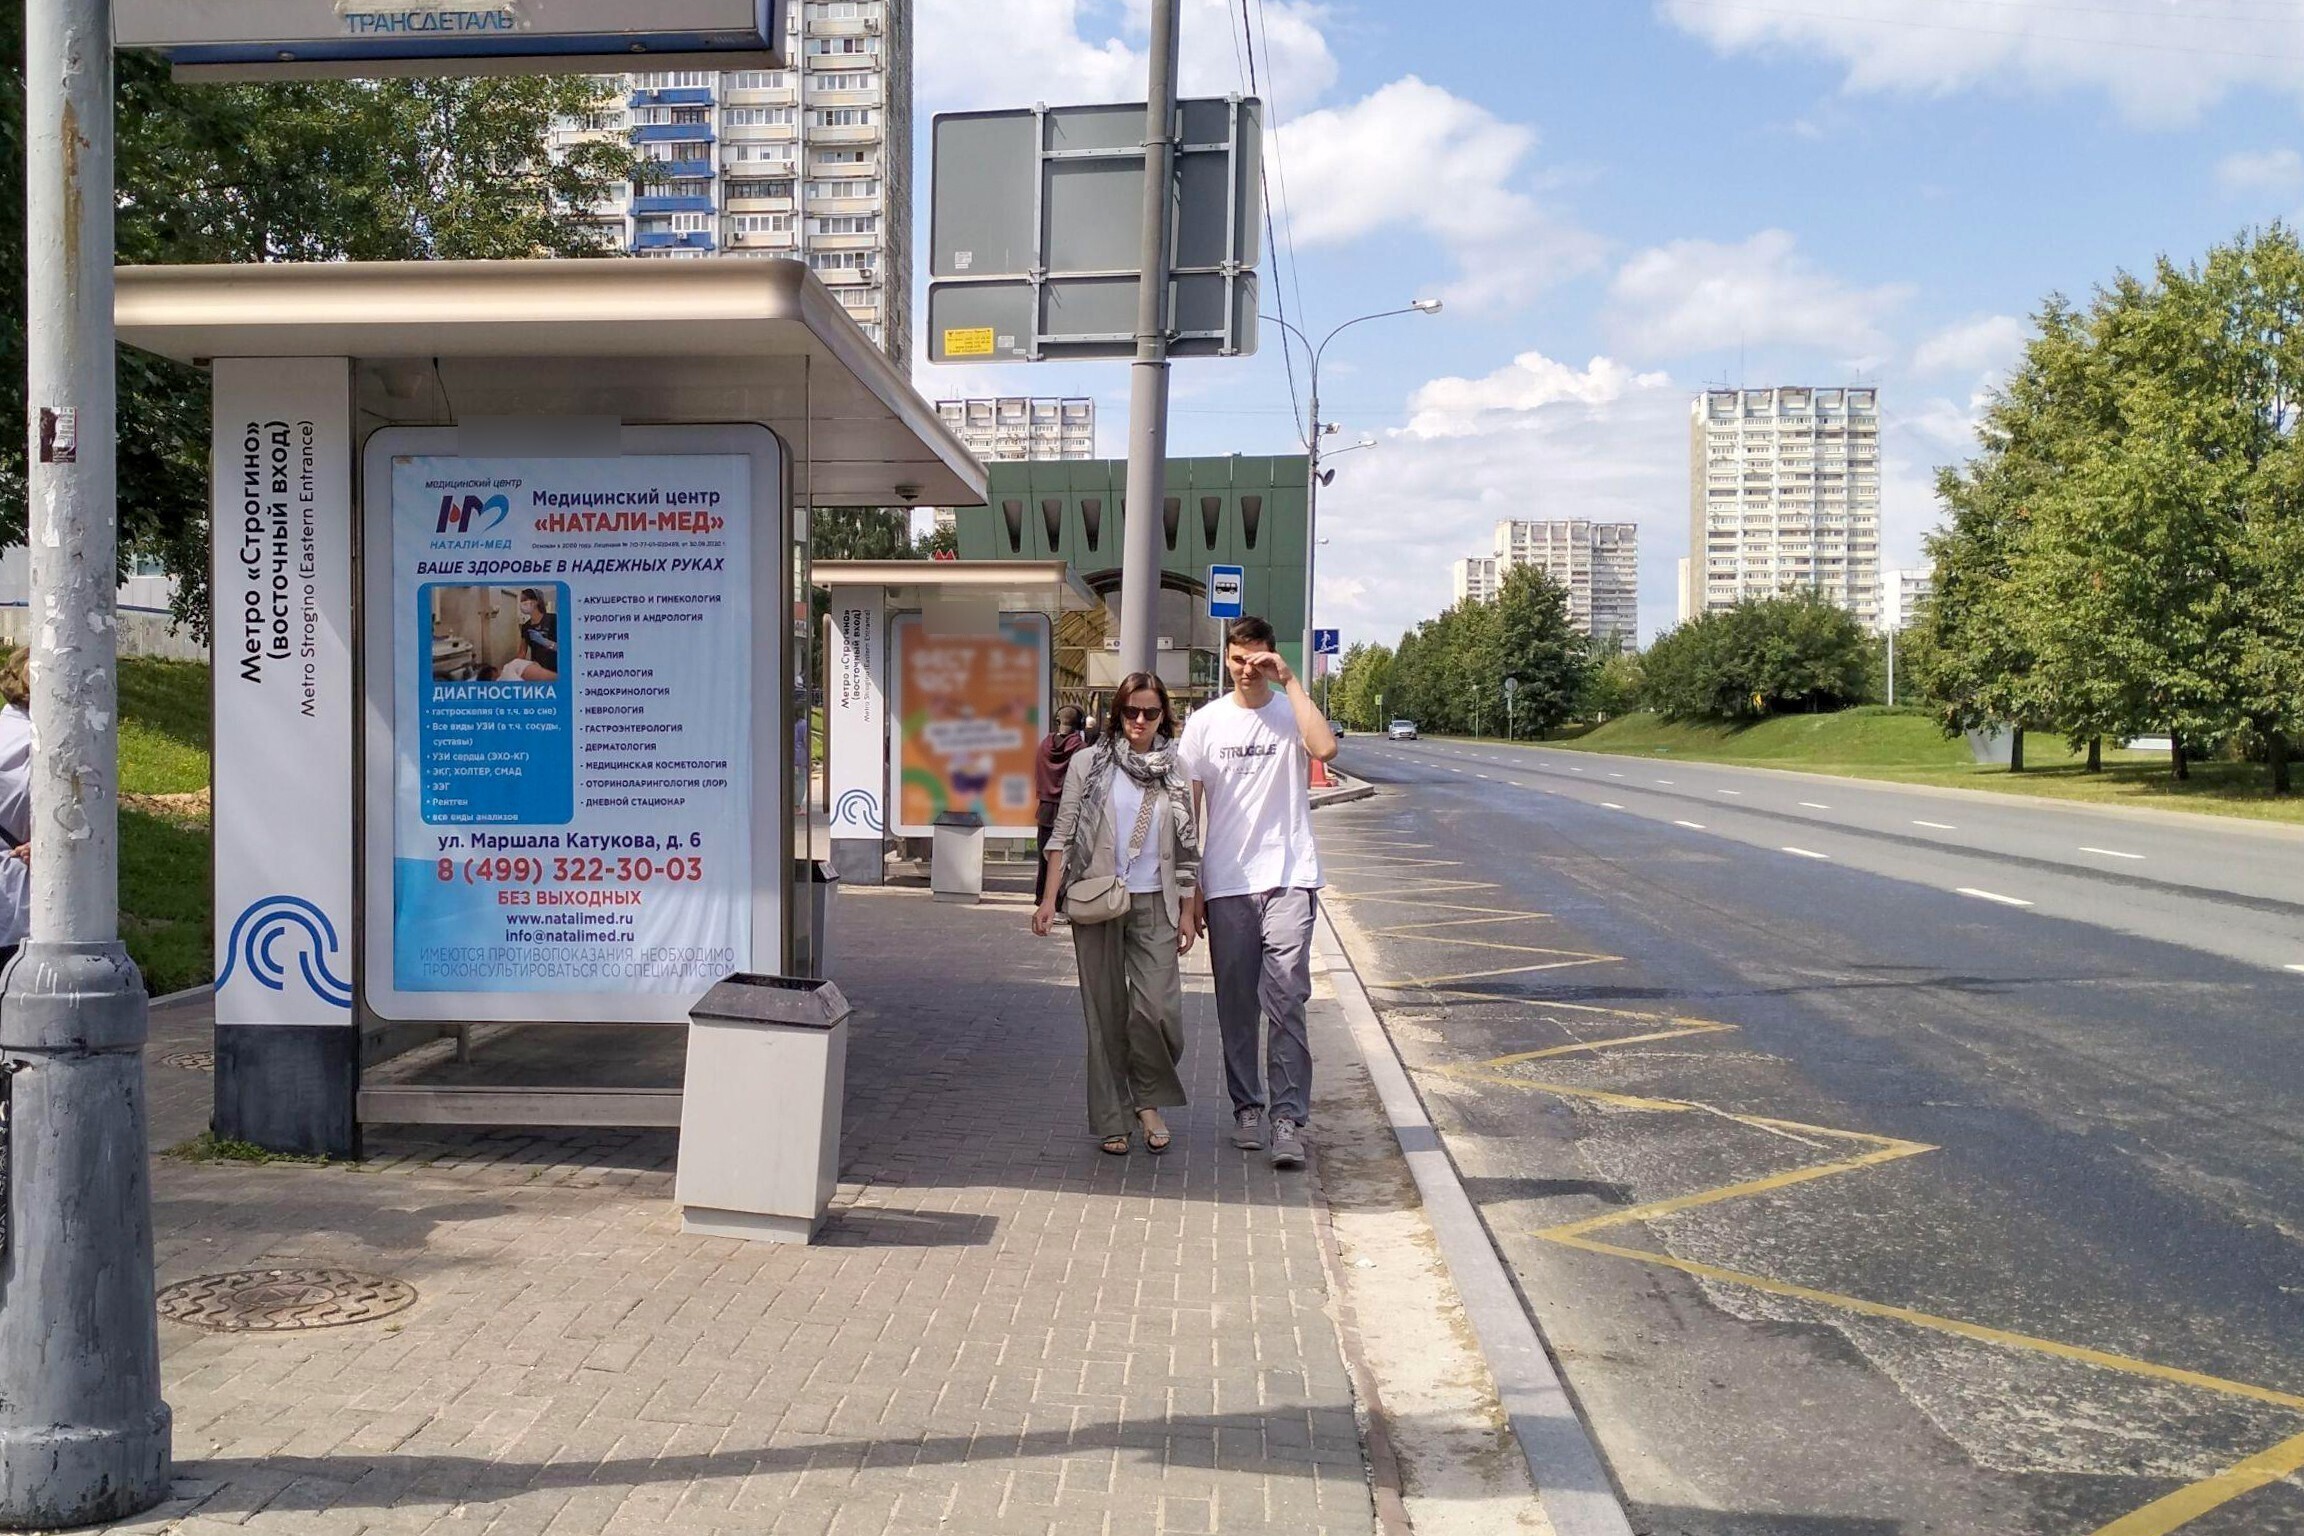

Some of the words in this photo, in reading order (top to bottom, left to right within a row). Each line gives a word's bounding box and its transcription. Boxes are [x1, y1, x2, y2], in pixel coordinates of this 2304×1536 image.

[264, 421, 291, 493] вход)
[297, 421, 314, 502] Entrance)
[425, 478, 490, 489] медицинский
[493, 479, 522, 489] центр
[240, 422, 265, 580] «Строгино»
[533, 488, 659, 507] Медицинский
[666, 491, 720, 506] центр
[534, 511, 724, 534] «НАТАЛИ-МЕД»
[299, 508, 315, 579] (Eastern
[430, 539, 512, 550] НАТАЛИ-МЕД
[417, 561, 463, 574] ВАШЕ
[467, 560, 552, 575] ЗДОРОВЬЕ
[557, 561, 566, 572] В
[572, 559, 667, 574] НАДЕЖНЫХ
[671, 558, 724, 571] РУКАХ
[266, 503, 291, 659] (восточный
[584, 596, 644, 604] АКУШЕРСТВО
[657, 595, 721, 603] ГИНЕКОЛОГИЯ
[301, 584, 318, 658] Strogino
[584, 615, 631, 623] УРОЛОГИЯ
[643, 614, 703, 622] АНДРОЛОГИЯ
[851, 610, 861, 637] вход)
[241, 591, 265, 683] Метро
[841, 610, 851, 669] «Строгино»
[584, 651, 624, 659] ТЕРАПИЯ
[587, 670, 653, 678] КАРДИОЛОГИЯ
[852, 641, 861, 700] (восточный
[301, 663, 315, 717] Metro
[432, 686, 556, 702] ДИАГНОСТИКА
[585, 688, 670, 696] ЭНДОКРИНОЛОГИЯ
[841, 673, 851, 709] Метро
[537, 707, 556, 715] сне)
[476, 722, 494, 730] УЗИ
[585, 724, 682, 733] ГАСТРОЭНТЕРОЛОГИЯ
[585, 743, 656, 752] ДЕРМАТОЛОГИЯ
[1220, 743, 1277, 759] STRUGGLE
[487, 752, 529, 761] (ЭХО-КГ)
[433, 768, 452, 776] ЭКГ,
[454, 768, 492, 776] ХОЛТЕР,
[495, 767, 522, 776] СМАД
[586, 761, 653, 770] МЕДИЦИНСКАЯ
[656, 761, 727, 769] КОСМЕТОЛОГИЯ
[586, 779, 700, 788] ОТОРИНОЛАРИНГОЛОГИЯ
[702, 779, 727, 788] (ЛОР)
[433, 798, 468, 806] Рентген
[586, 797, 628, 807] ДНЕВНОЙ
[631, 798, 685, 807] СТАЦИОНАР
[438, 835, 464, 850] ул.
[471, 833, 560, 850] Маршала
[567, 832, 660, 851] Катукова,
[667, 836, 682, 850] д.
[690, 832, 701, 847] 6
[438, 858, 453, 881] 8
[464, 858, 542, 885] (499)
[553, 857, 703, 881] 322-30-03
[498, 891, 530, 905] БЕЗ
[537, 890, 642, 907] ВЫХОДНЫХ
[506, 912, 633, 925] www.natalimed.ru
[505, 929, 635, 944] info@natalimed.ru
[420, 948, 485, 961] ИМЕЮТСЯ
[641, 948, 734, 962] НЕОБХОДИМО
[423, 963, 598, 978] ПРОКОНСУЛЬТИРОВАТЬСЯ
[602, 963, 620, 977] СО
[625, 963, 735, 978] СПЕЦИАЛИСТОМ
